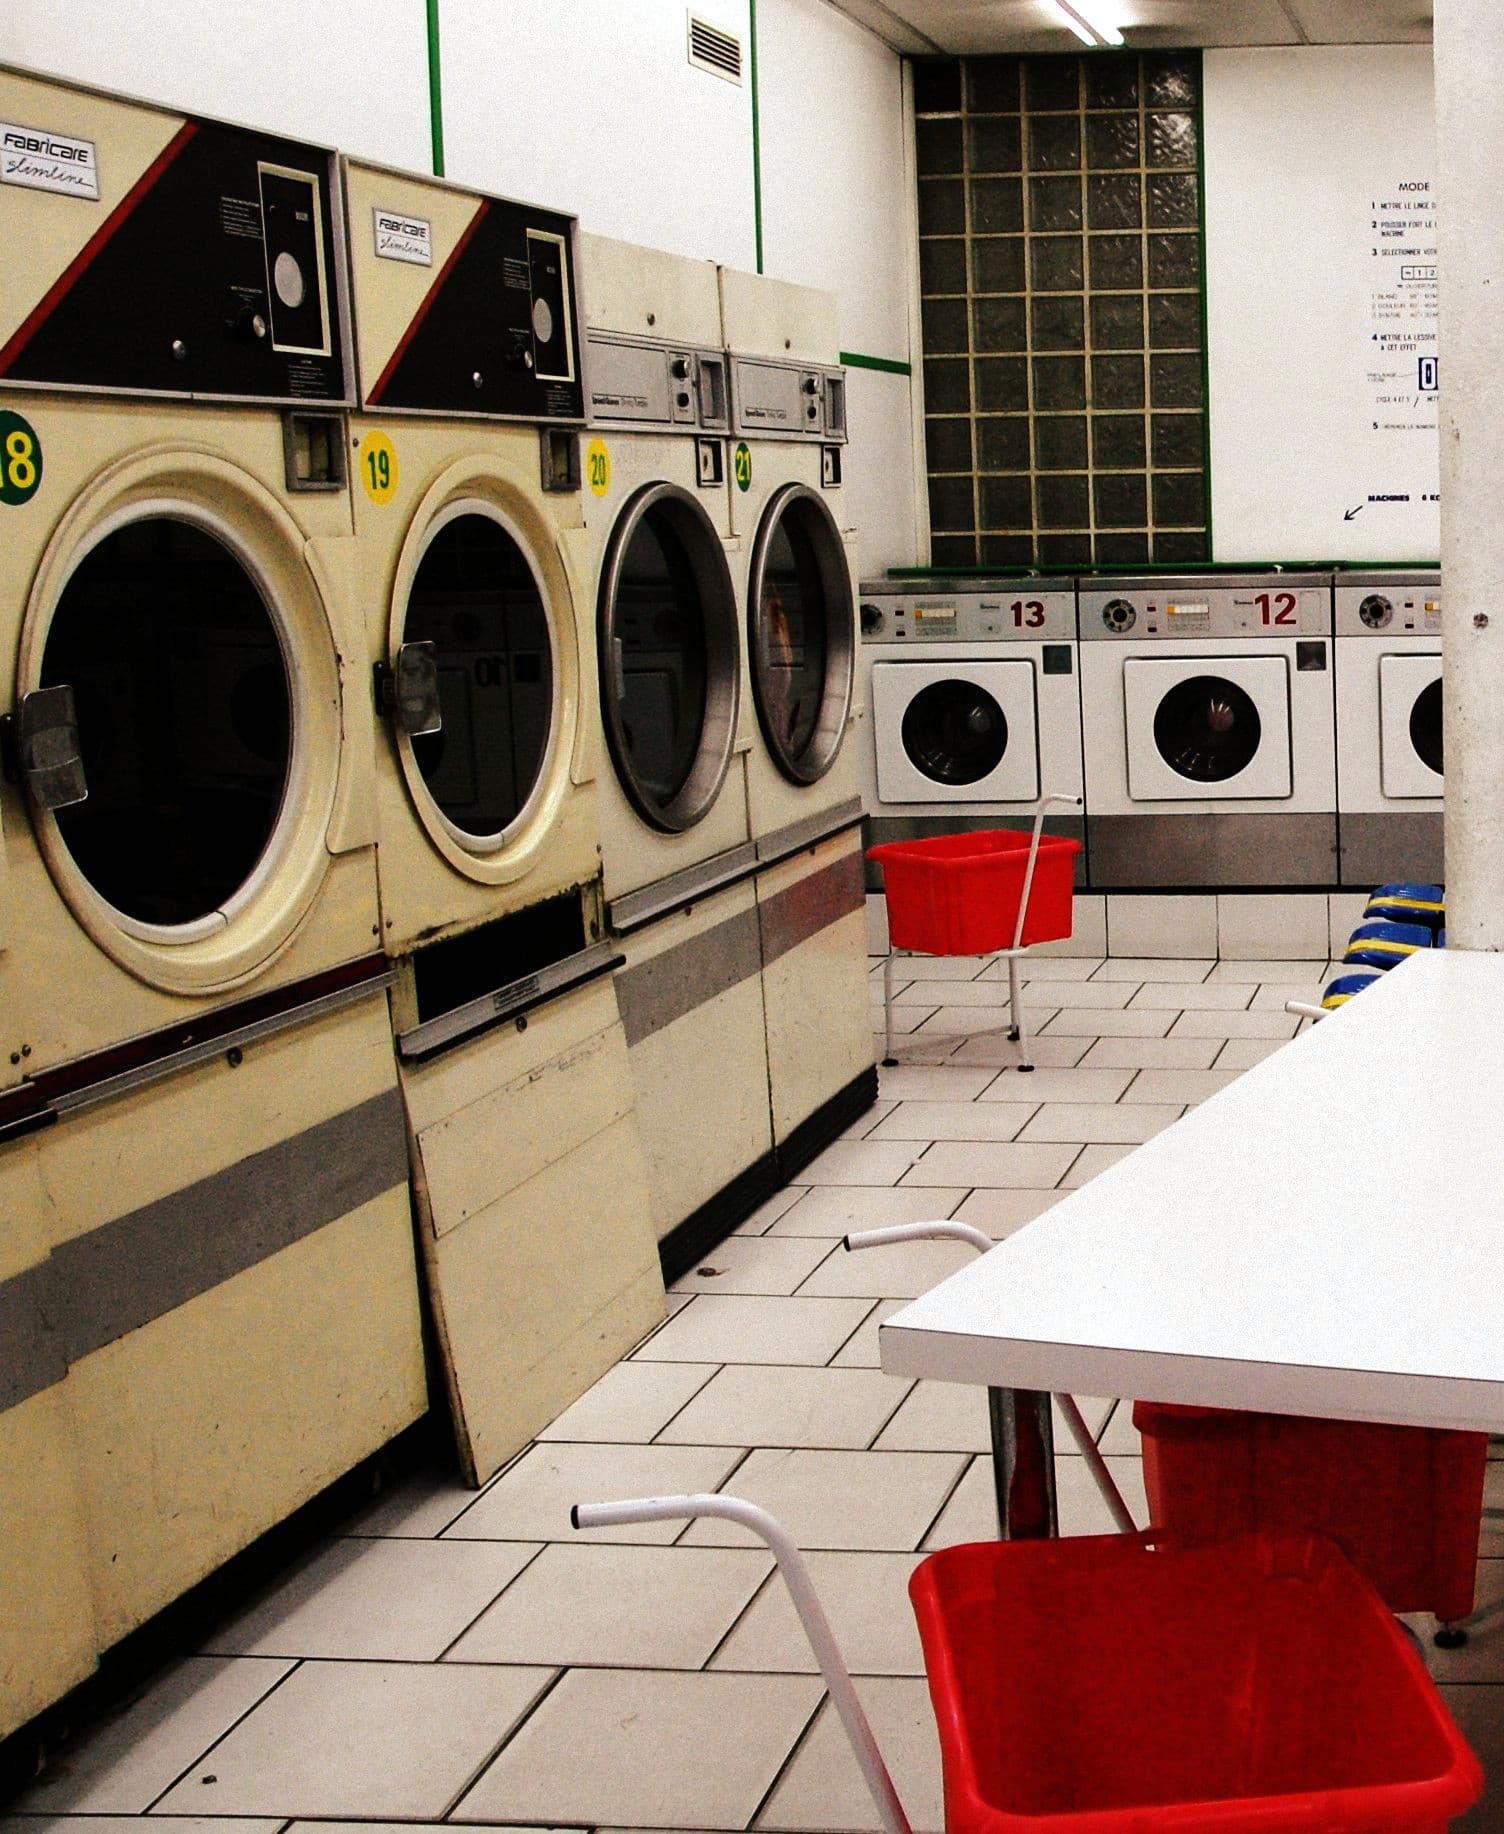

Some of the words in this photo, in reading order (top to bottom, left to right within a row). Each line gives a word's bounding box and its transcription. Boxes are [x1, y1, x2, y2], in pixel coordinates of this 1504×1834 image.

[1398, 182, 1430, 192] MODE
[1372, 220, 1377, 228] 2
[1372, 248, 1377, 256] 3
[1372, 333, 1378, 341] 4
[368, 449, 390, 489] 19
[591, 454, 606, 486] 20
[736, 451, 750, 481] 21
[1368, 494, 1410, 502] MACHINES
[1010, 601, 1045, 628] 13
[1255, 593, 1297, 626] 12
